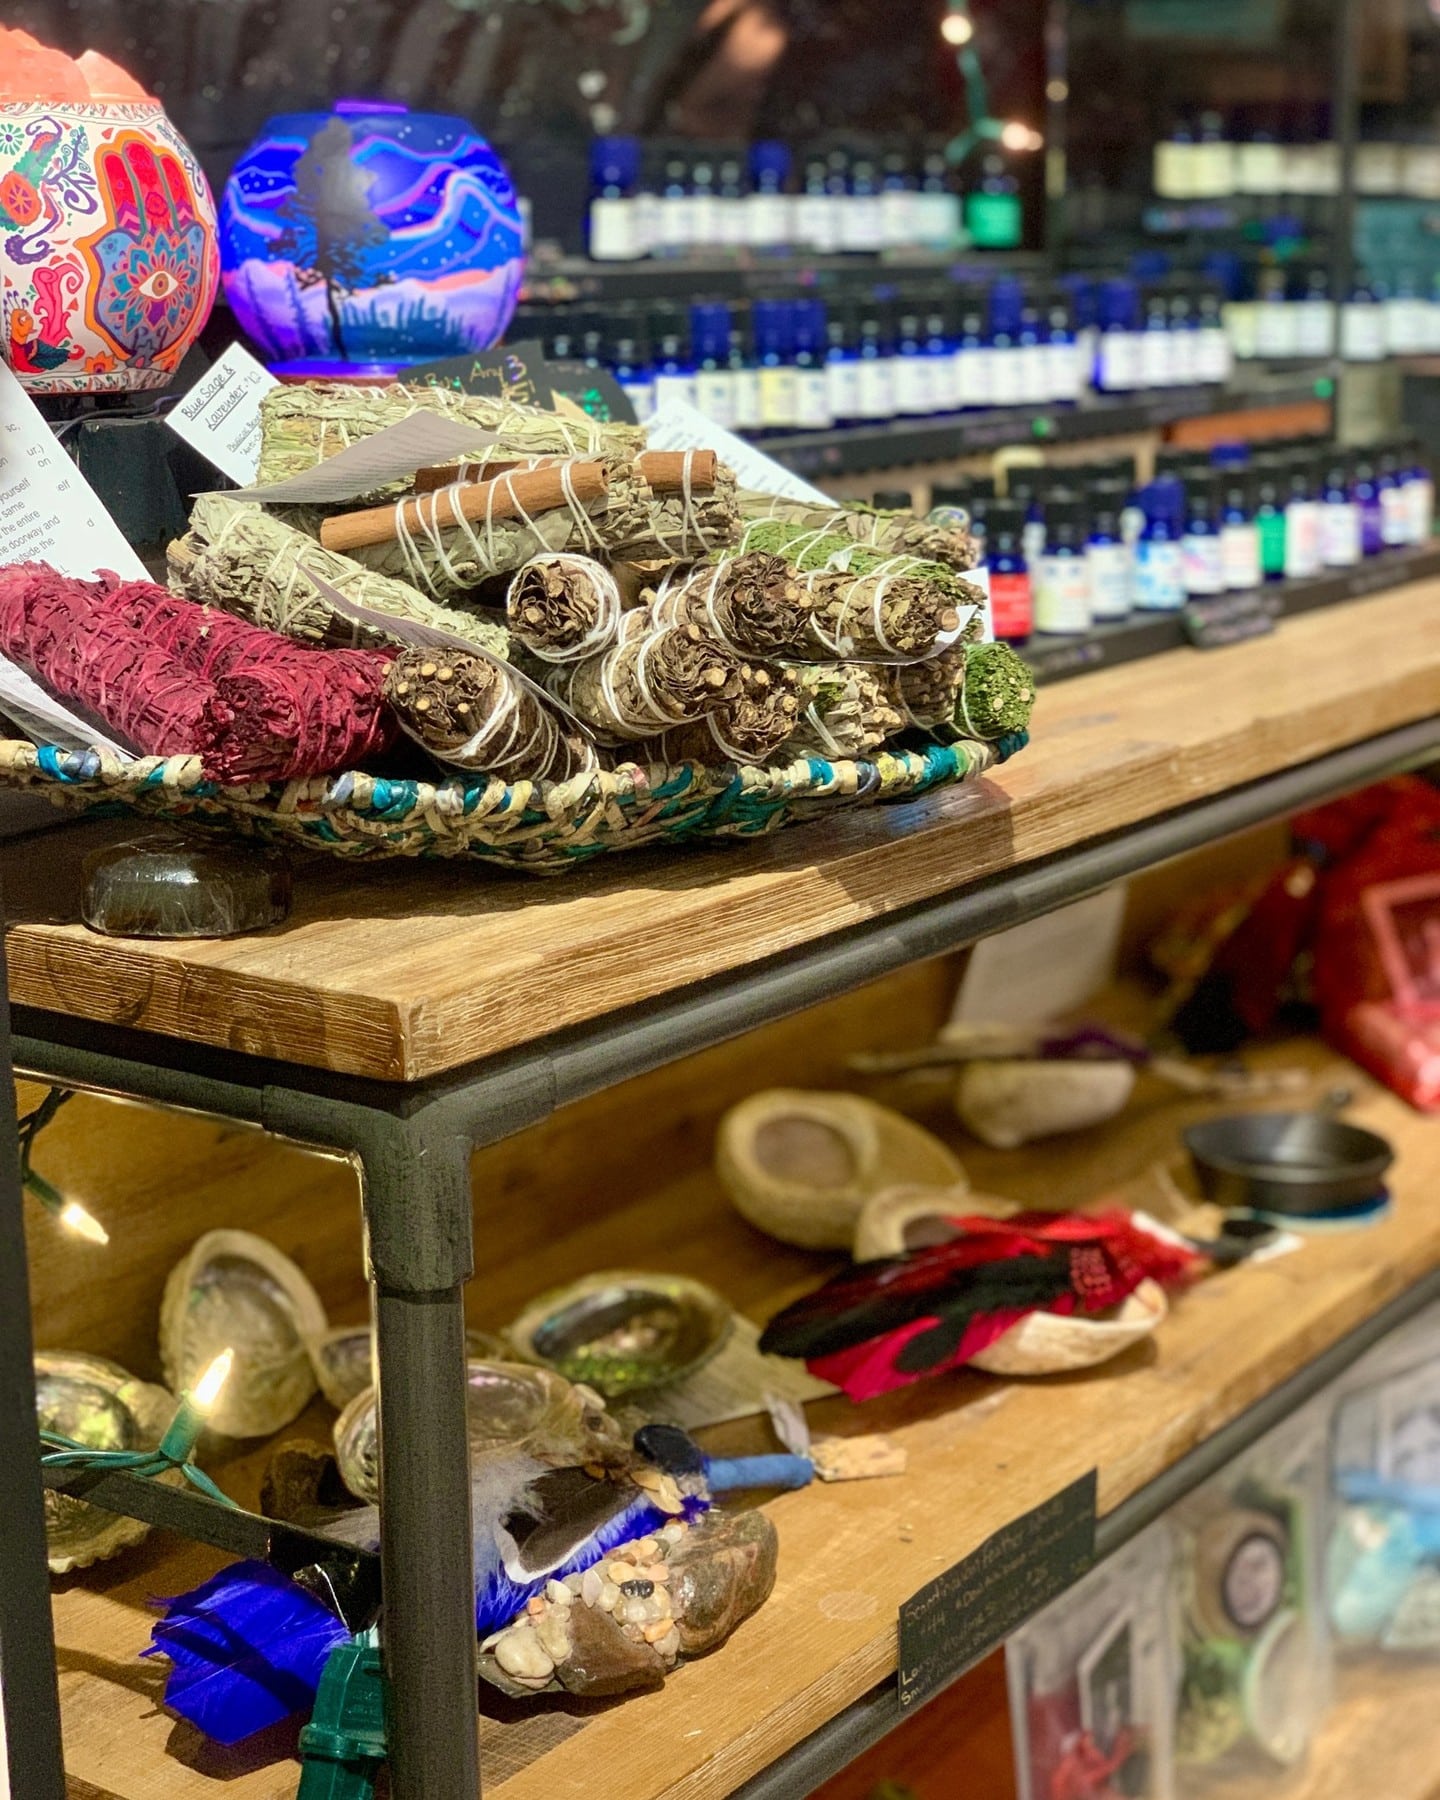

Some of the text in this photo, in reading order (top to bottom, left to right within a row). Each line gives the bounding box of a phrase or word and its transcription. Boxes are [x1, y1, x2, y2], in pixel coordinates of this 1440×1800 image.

[470, 360, 506, 386] Any
[505, 354, 527, 380] 3
[181, 364, 235, 418] Blue Sage &
[205, 384, 246, 430] Lavender
[1, 501, 25, 518] same
[1, 510, 40, 536] the entire
[9, 526, 44, 549] doorway
[43, 515, 60, 530] and
[39, 538, 55, 550] the
